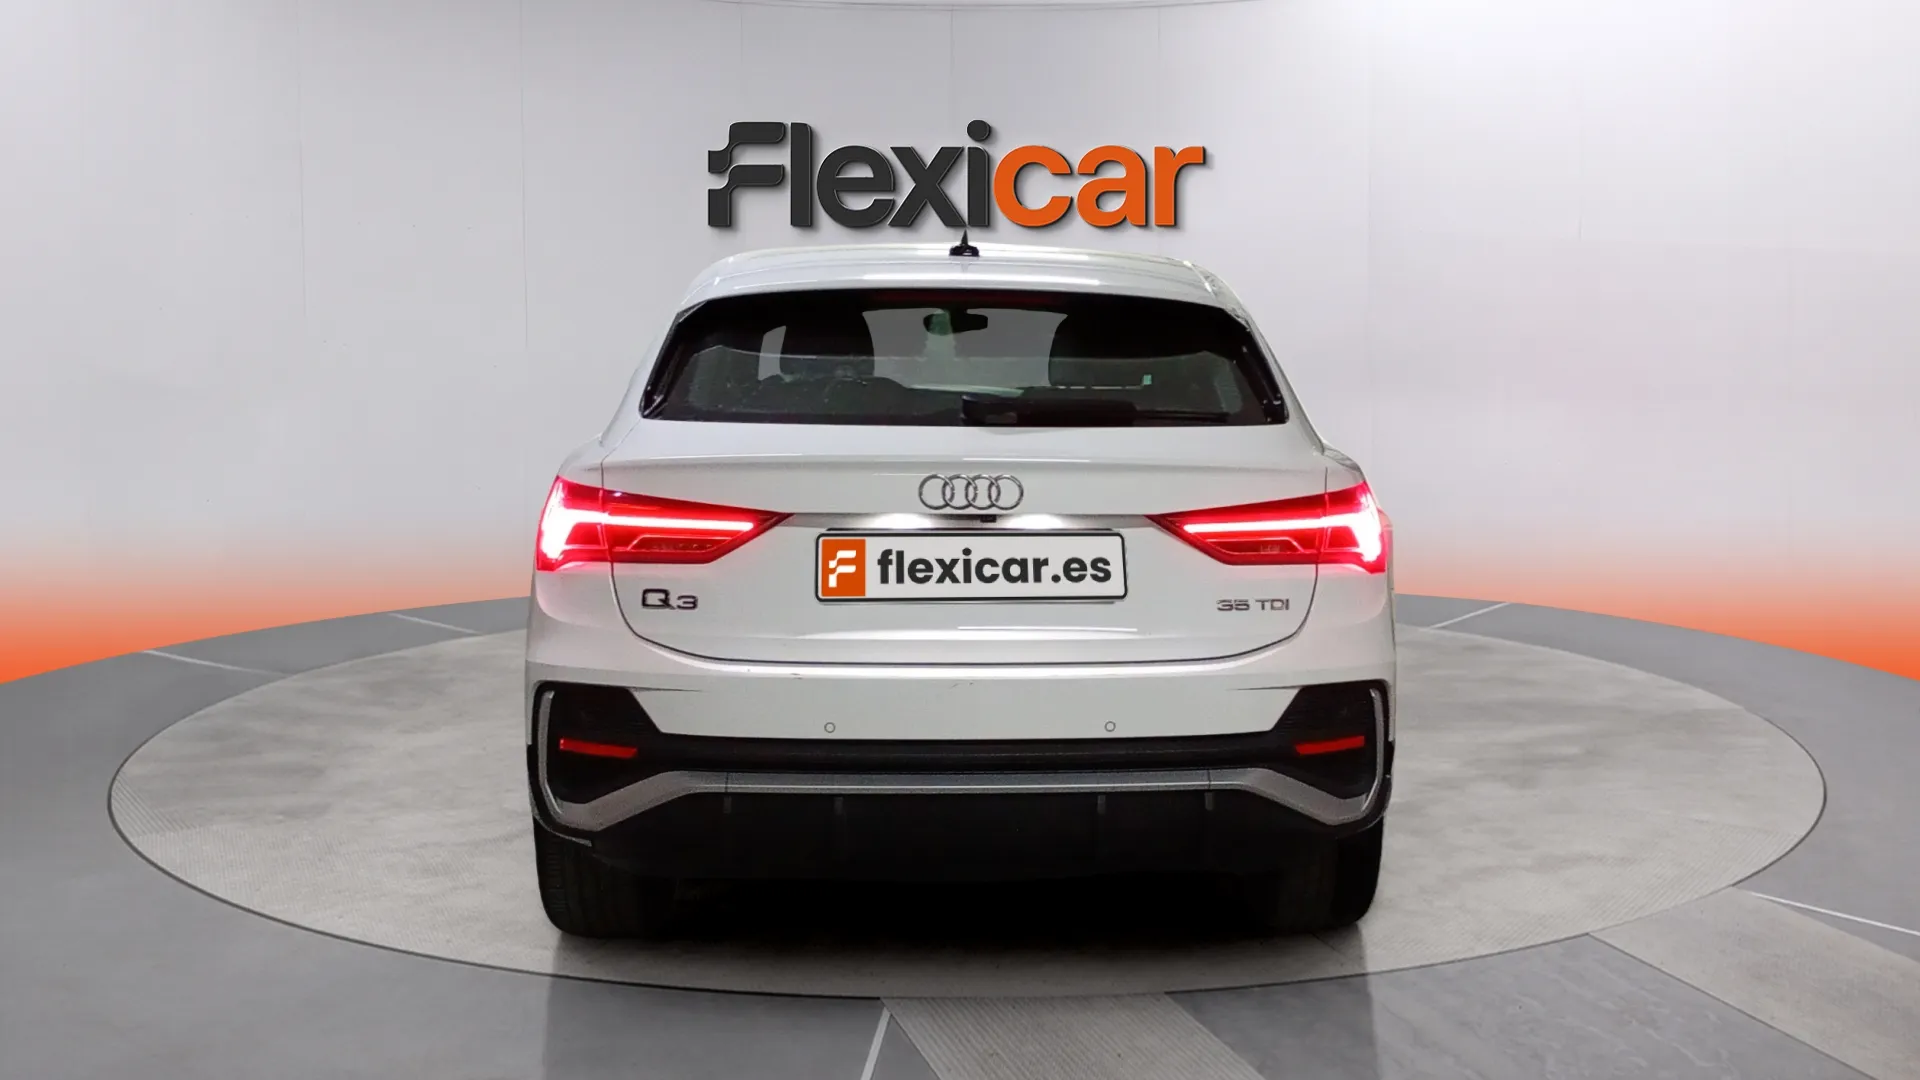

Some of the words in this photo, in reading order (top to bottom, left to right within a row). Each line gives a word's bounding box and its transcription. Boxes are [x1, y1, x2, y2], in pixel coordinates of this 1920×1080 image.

[707, 119, 1206, 228] Flexicar
[877, 547, 1112, 584] flexicar.es
[641, 588, 699, 610] Q3
[1216, 598, 1250, 611] 35
[1254, 598, 1289, 611] TDI
